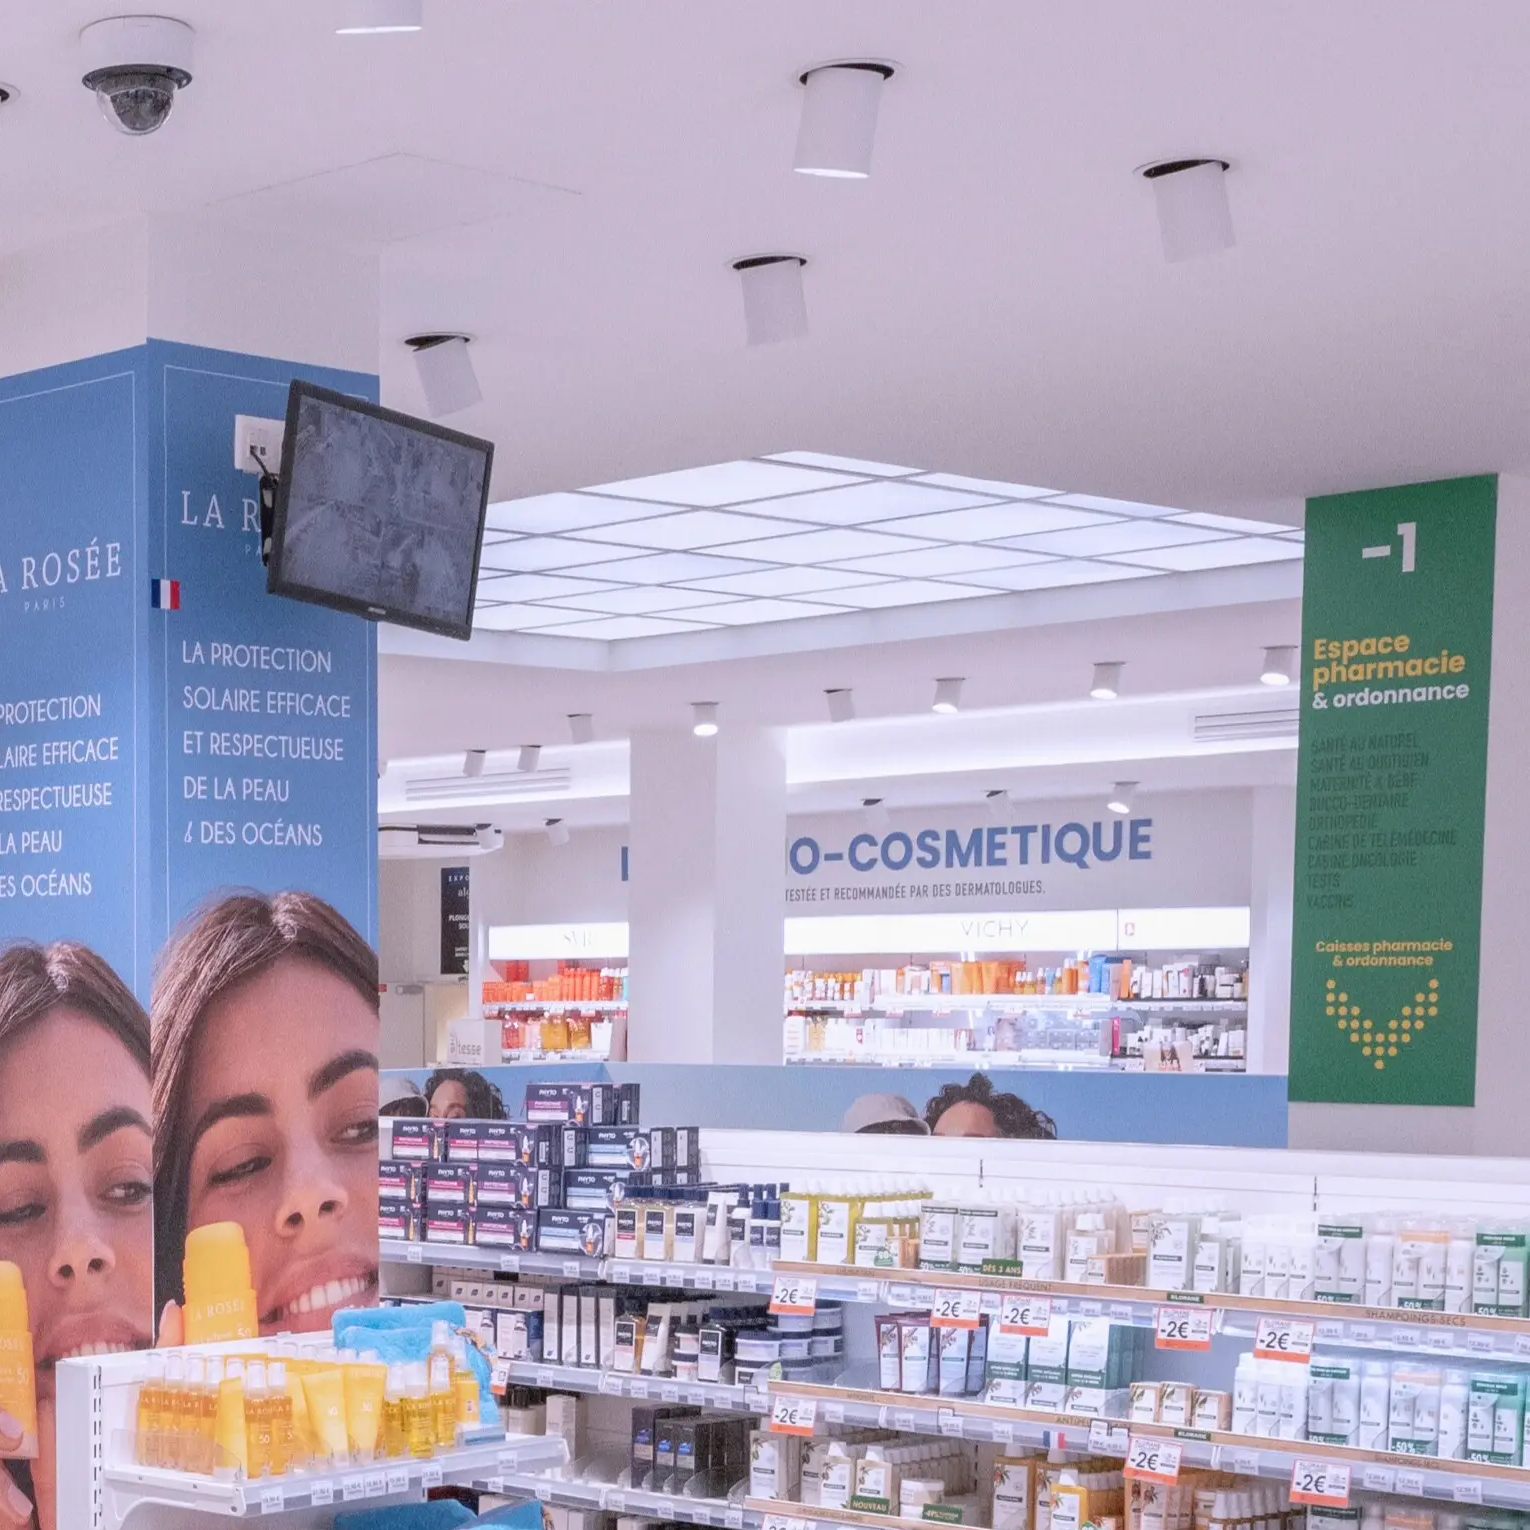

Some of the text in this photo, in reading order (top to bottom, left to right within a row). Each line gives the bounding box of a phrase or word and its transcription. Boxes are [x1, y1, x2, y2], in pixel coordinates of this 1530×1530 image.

[181, 490, 225, 528] LA
[21, 537, 122, 591] ROSÉE
[24, 597, 66, 612] PARIS
[183, 641, 332, 673] LA PROTECTION
[1313, 634, 1410, 664] Espace
[1313, 652, 1466, 690] pharmacie
[183, 686, 351, 718] SOLAIRE EFFICACE
[1312, 681, 1470, 710] & ordonnance
[42, 737, 119, 765] EFFICACE
[184, 731, 344, 761] ET RESPECTUEUSE
[184, 776, 289, 802] DE LA PEAU
[21, 830, 62, 854] PEAU
[200, 818, 322, 847] DES OCÉANS
[20, 867, 92, 896] OCÉANS
[820, 888, 830, 900] ET
[834, 883, 906, 900] RECOMMANDÉE
[910, 885, 929, 898] PAR
[932, 883, 951, 897] DES
[955, 880, 1046, 896] DERMATOLOGUES.
[961, 920, 1029, 938] VICHY
[1315, 938, 1453, 954] Caisses pharmacie
[1333, 954, 1434, 967] & ordonnance
[1006, 1266, 1021, 1275] ANS
[935, 1301, 961, 1318] -2€
[1004, 1308, 1029, 1325] -2€
[1160, 1321, 1190, 1338] -2€
[1440, 1315, 1466, 1327] SECS
[1258, 1332, 1290, 1350] -2€
[1130, 1452, 1159, 1471] -2€
[853, 1500, 887, 1511] NOUVEAU
